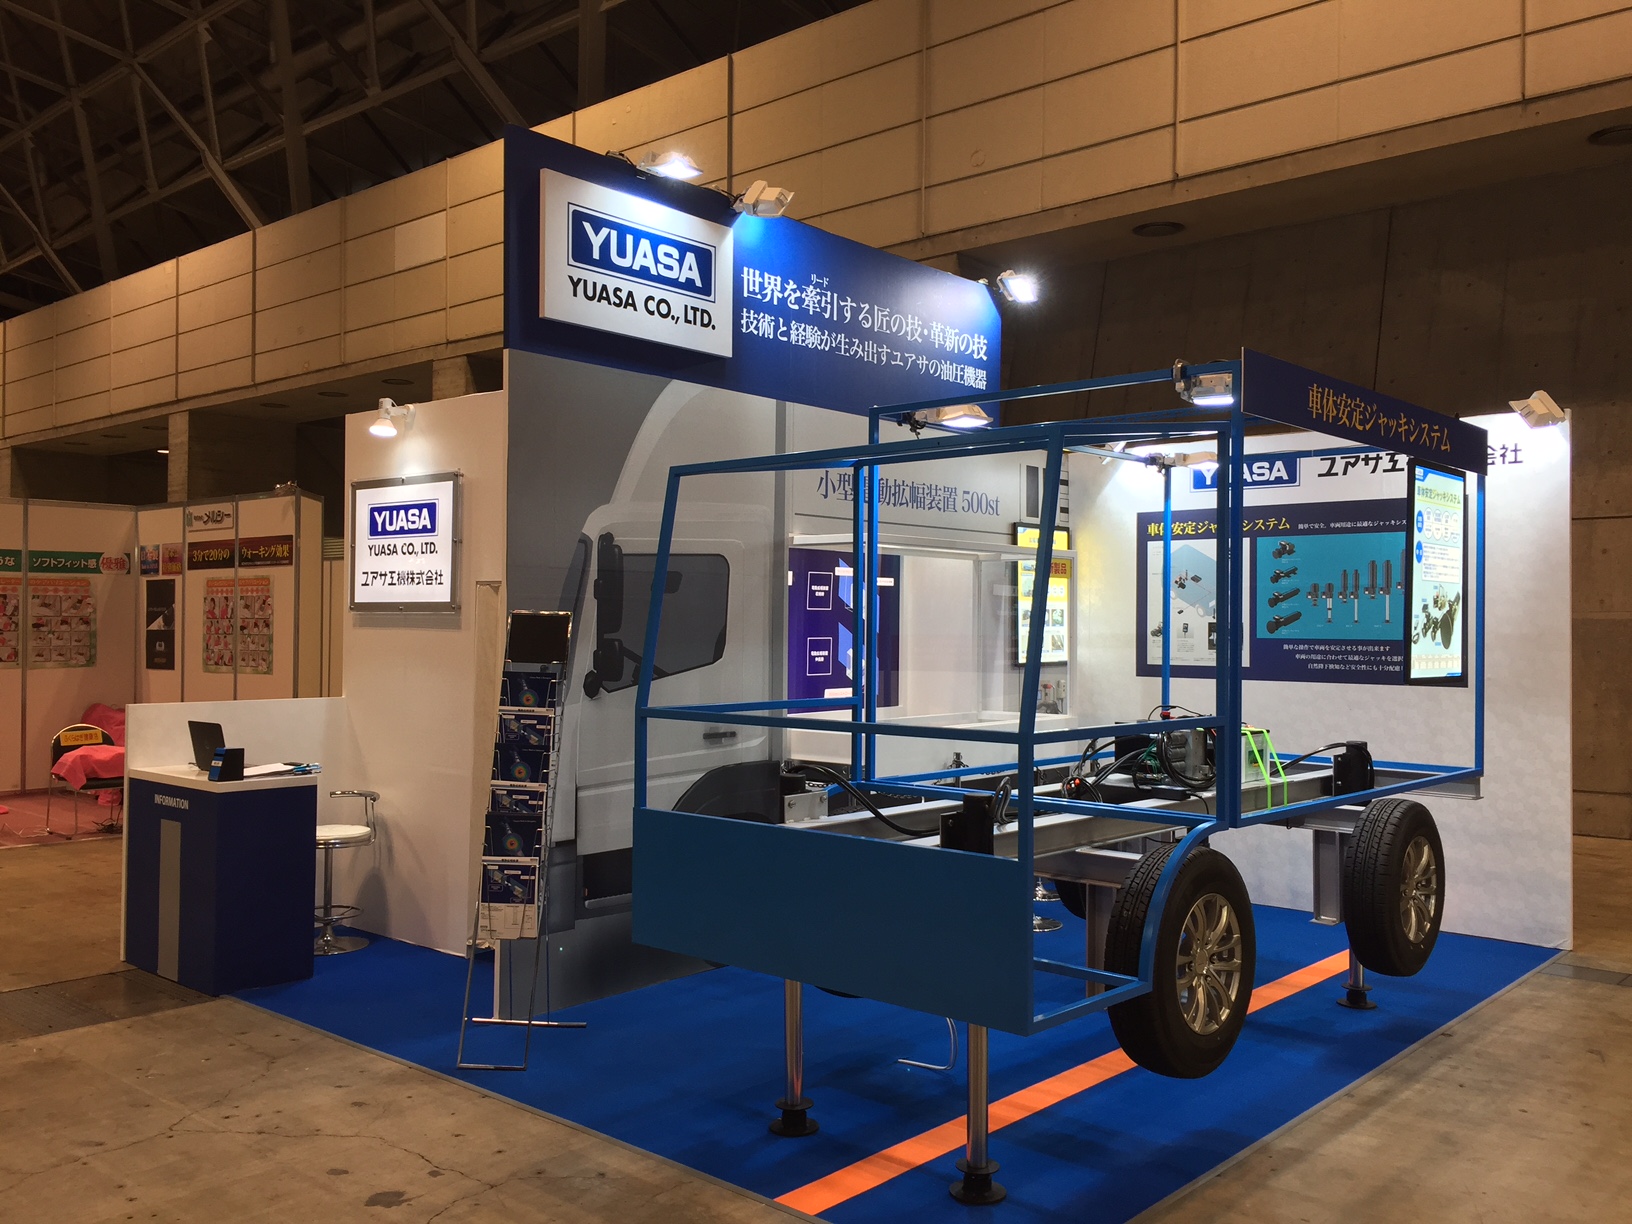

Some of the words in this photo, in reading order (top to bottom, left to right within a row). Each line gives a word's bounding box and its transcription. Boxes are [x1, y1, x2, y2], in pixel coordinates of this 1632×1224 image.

[582, 221, 702, 288] YUASA
[567, 275, 638, 312] YUASA
[643, 295, 680, 325] CO.,
[683, 304, 716, 331] LTD.
[741, 266, 988, 361] 世界を牽引する匠の技・革新の技
[740, 308, 987, 390] 技術と経験が生み出すユアサの油圧機器
[1307, 383, 1451, 452] 車体安定ジャッキシステム
[816, 469, 958, 513] 小型動拡幅装置
[961, 490, 1000, 516] 500st
[374, 507, 431, 532] YUASA
[368, 543, 398, 556] YUASA
[420, 541, 438, 555] LTD.
[361, 569, 444, 587] ユアサ工機株式会社
[154, 793, 189, 810] INFORMATION
